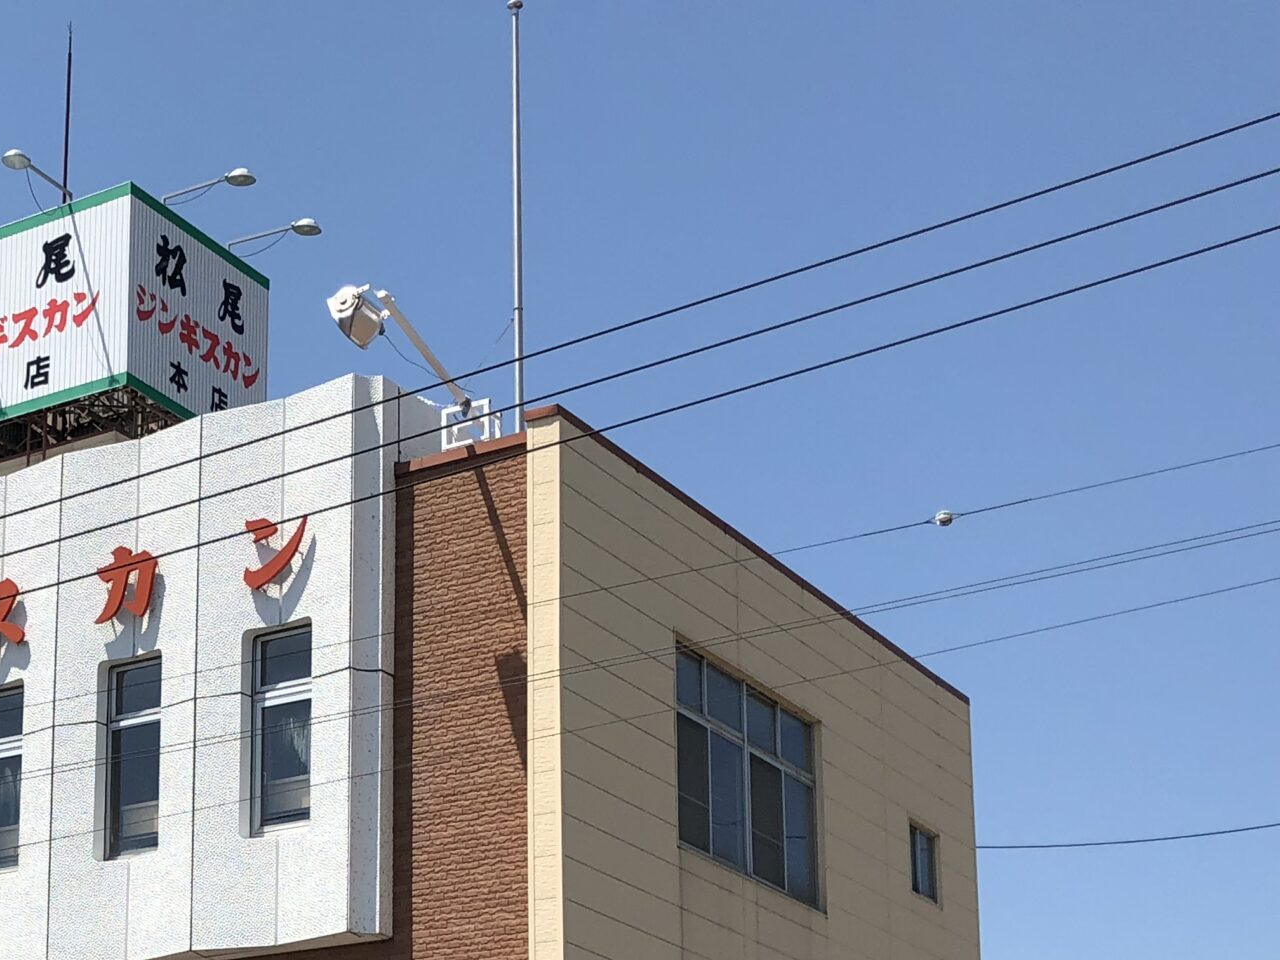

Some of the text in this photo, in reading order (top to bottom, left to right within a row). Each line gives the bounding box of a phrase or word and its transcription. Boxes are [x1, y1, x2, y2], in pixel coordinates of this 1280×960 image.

[155, 234, 245, 335] 松尾
[136, 284, 260, 389] ジンギスカン
[169, 361, 228, 411] 本店
